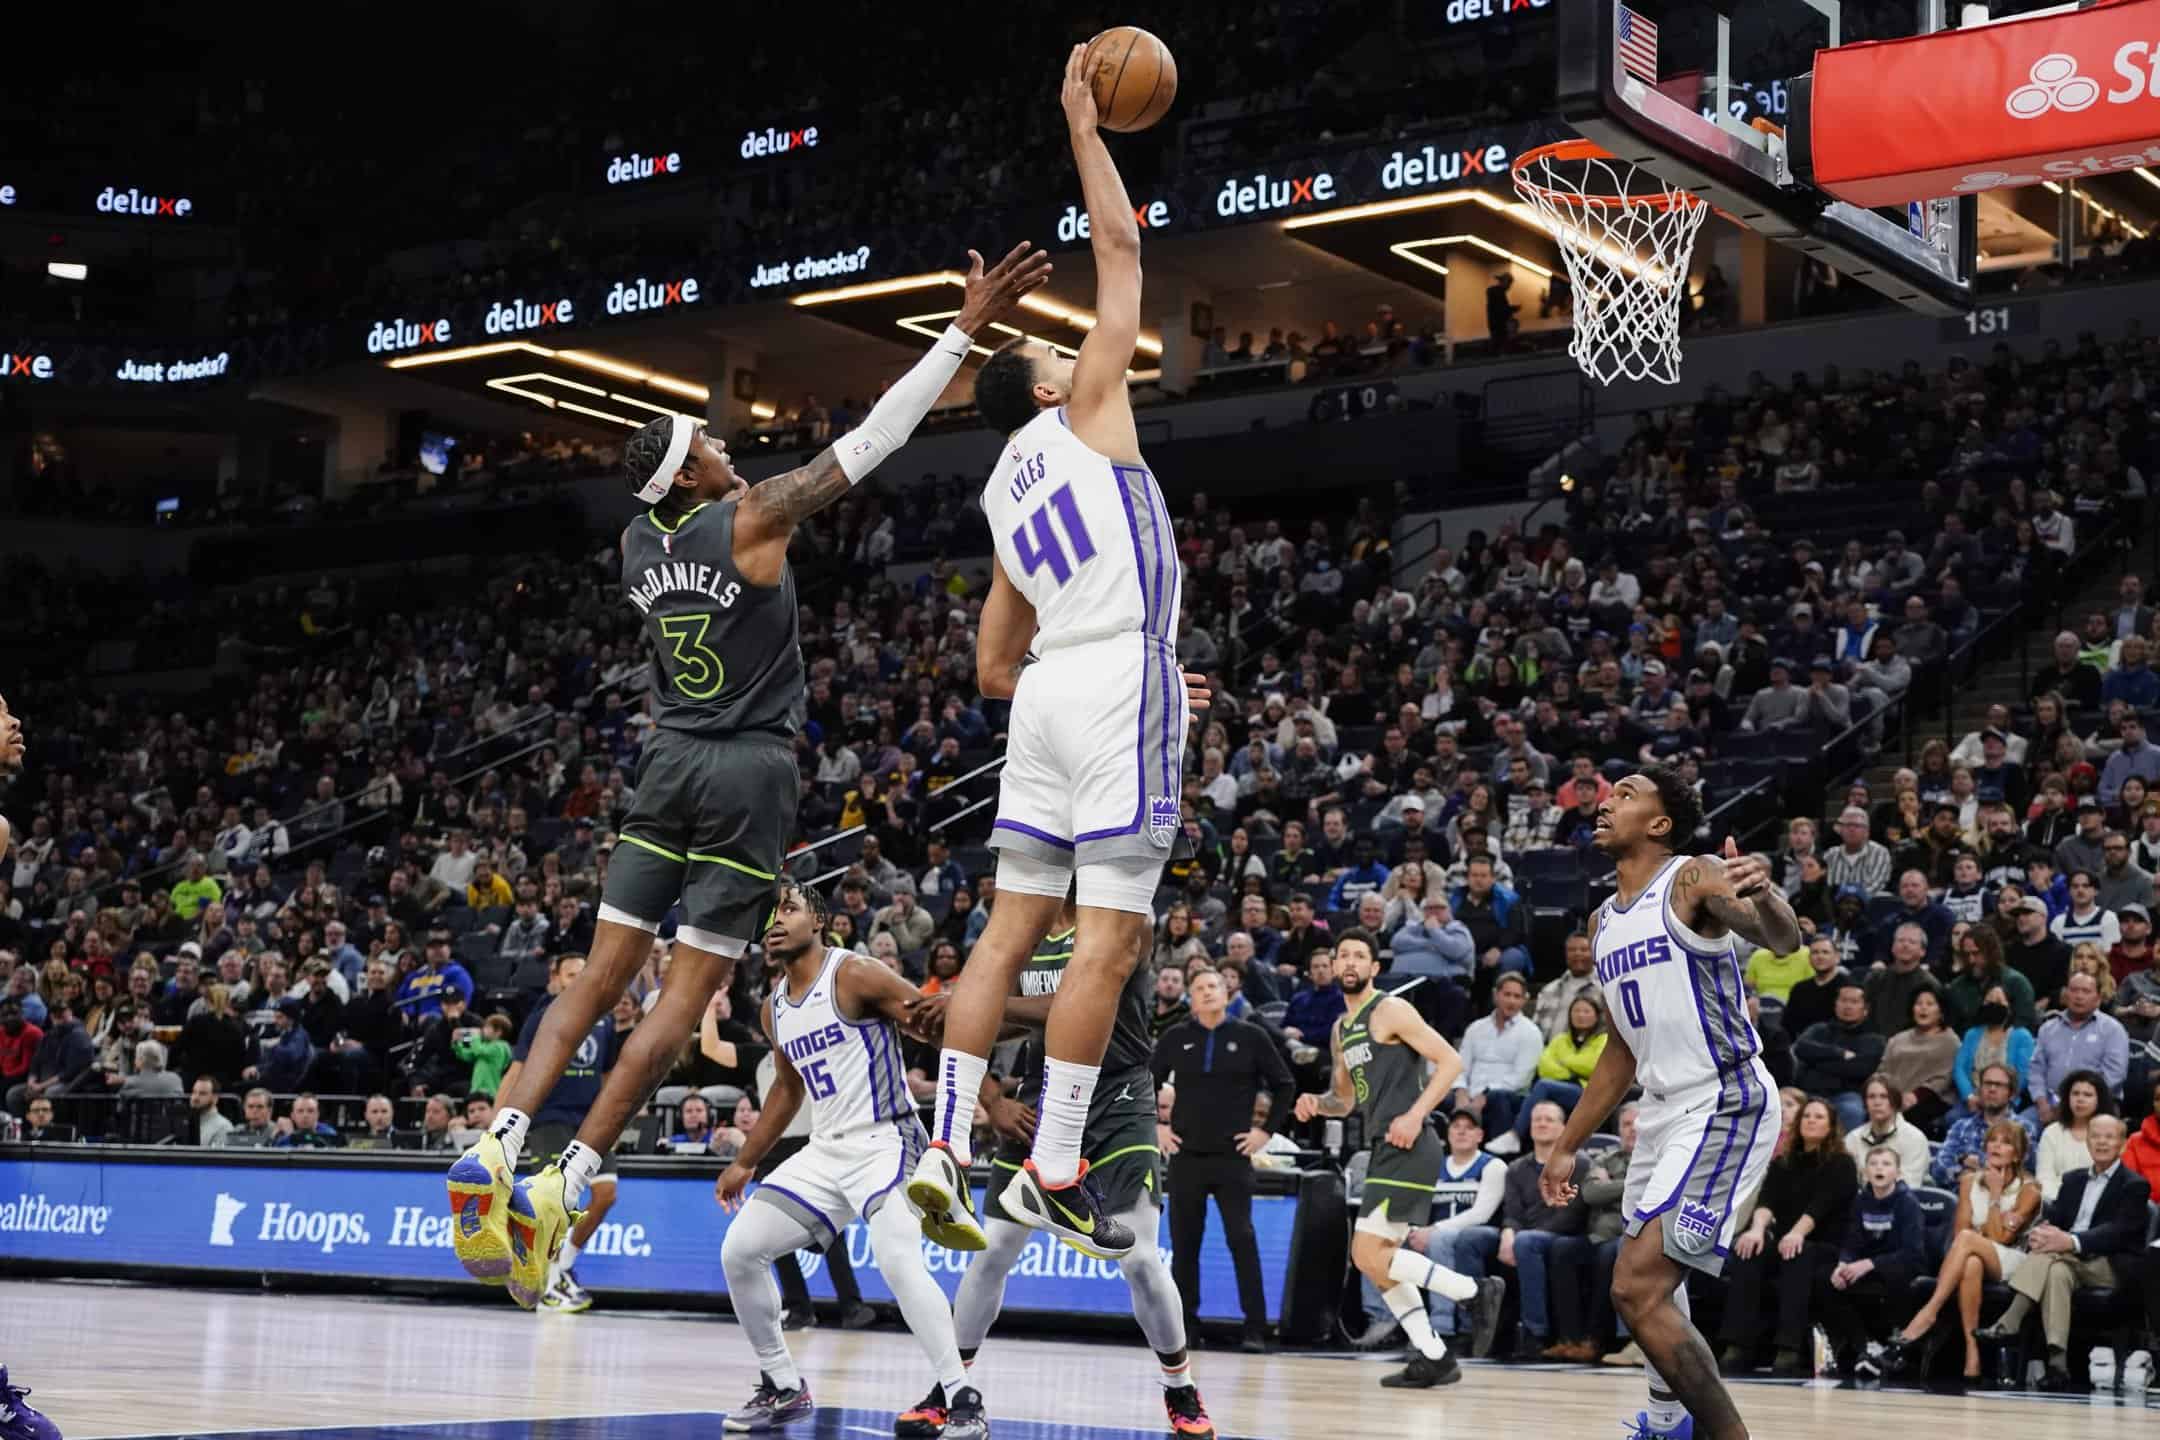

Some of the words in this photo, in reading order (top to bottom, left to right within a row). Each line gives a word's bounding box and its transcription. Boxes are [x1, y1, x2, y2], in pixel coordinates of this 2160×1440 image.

[740, 126, 818, 159] deluxe
[606, 152, 681, 184] deluxe
[1382, 143, 1509, 190] deluxe
[96, 186, 192, 217] deluxe
[1217, 173, 1337, 217] deluxe
[1058, 201, 1171, 242] dexe
[751, 263, 790, 288] Just
[793, 246, 871, 281] checks?
[485, 299, 575, 335] deluxe
[606, 277, 701, 316] deluxe
[367, 317, 452, 353] deluxe
[1964, 306, 2009, 335] 131
[117, 358, 164, 382] Just
[167, 352, 229, 382] checks?
[1010, 451, 1046, 504] LYLES
[1011, 480, 1099, 589] 41
[628, 561, 742, 614] McDANIELS
[659, 614, 725, 699] 3
[1597, 934, 1673, 984] KINGS
[1620, 979, 1647, 1029] 0
[782, 1021, 847, 1064] KINGS
[800, 1058, 838, 1102] 15
[257, 1201, 371, 1254] Hoops.
[1678, 1215, 1713, 1238] SAC
